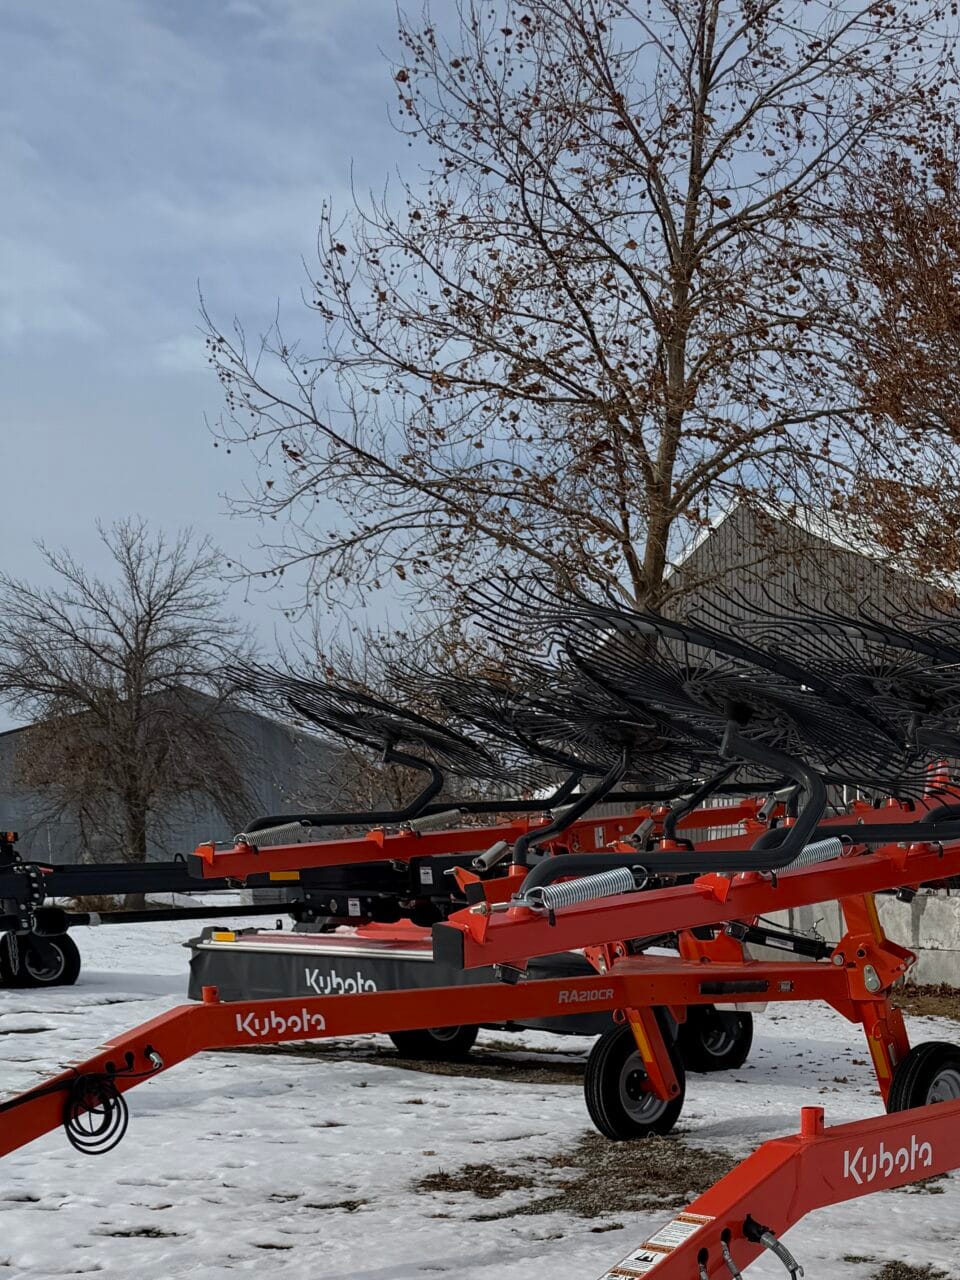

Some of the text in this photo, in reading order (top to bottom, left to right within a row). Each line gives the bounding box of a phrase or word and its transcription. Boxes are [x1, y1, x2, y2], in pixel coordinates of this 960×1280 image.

[305, 968, 377, 995] Kubota
[558, 988, 615, 1004] RA210CR
[235, 1007, 326, 1037] Kubota
[843, 1134, 933, 1185] Kubota
